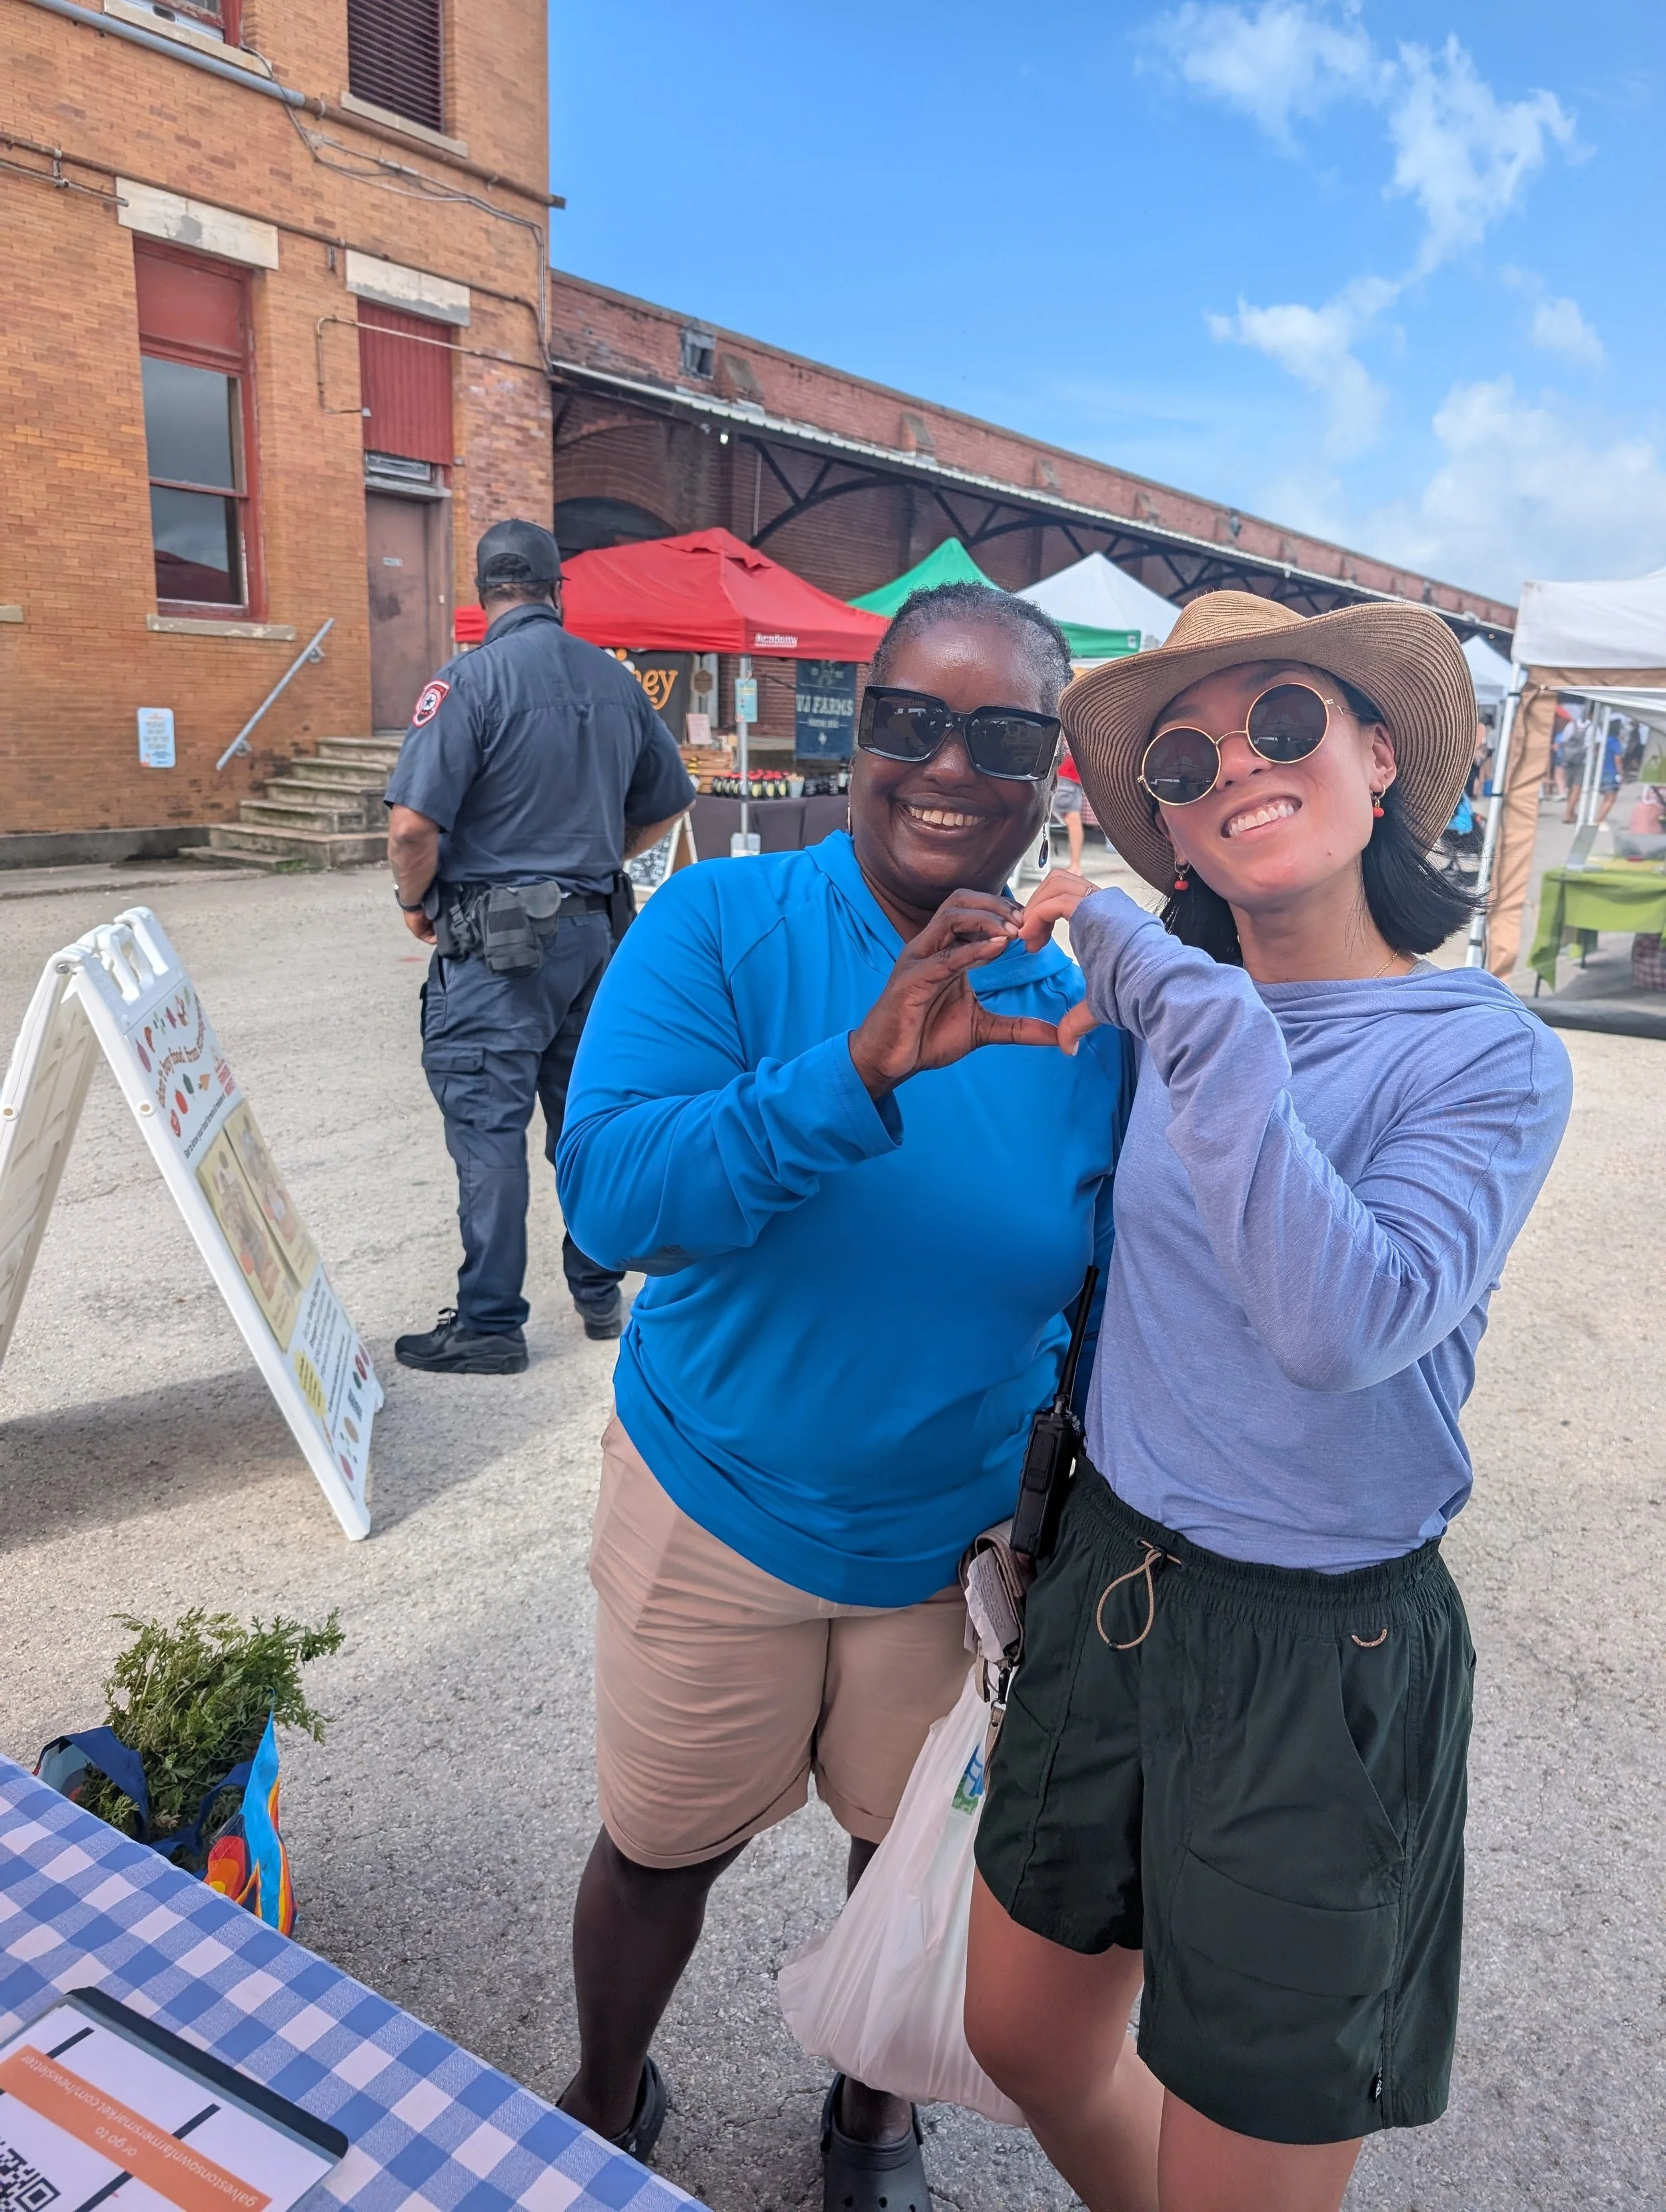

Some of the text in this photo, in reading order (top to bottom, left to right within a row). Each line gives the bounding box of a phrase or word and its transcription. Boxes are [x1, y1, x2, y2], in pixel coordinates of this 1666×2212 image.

[632, 669, 678, 710] ey
[159, 1054, 175, 1074] buy
[169, 1047, 185, 1065] food
[155, 1069, 168, 1108] don't
[21, 2054, 258, 2207] galvestonsownfarmersmarket.com/newsletter
[95, 2125, 137, 2157] or go to
